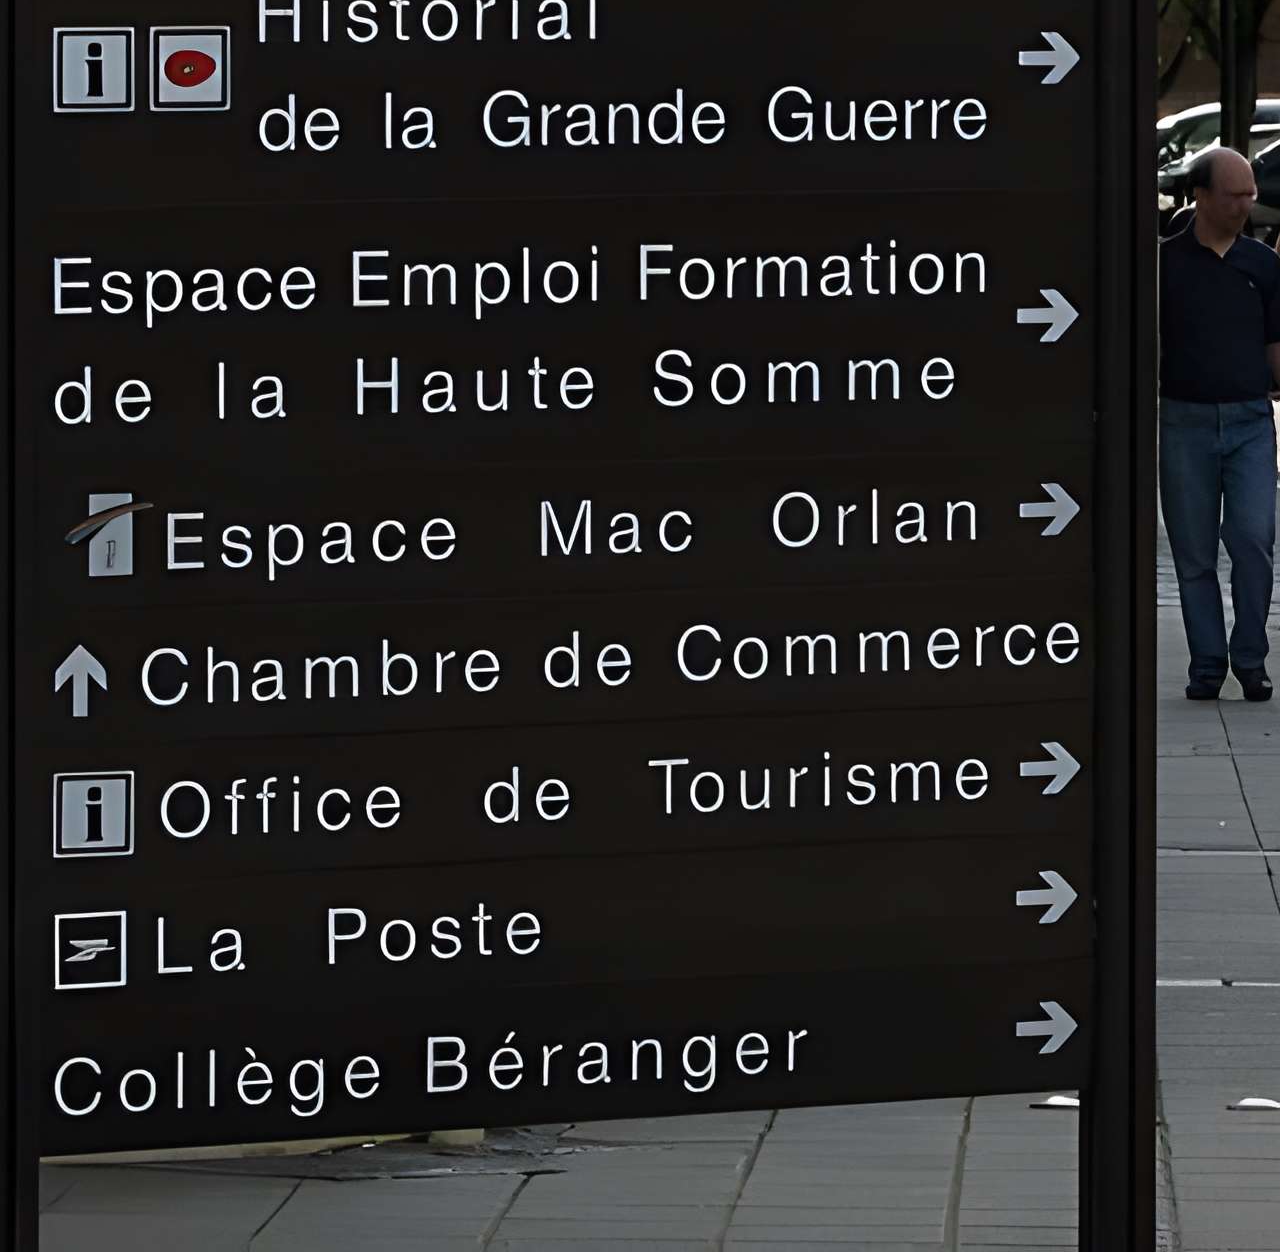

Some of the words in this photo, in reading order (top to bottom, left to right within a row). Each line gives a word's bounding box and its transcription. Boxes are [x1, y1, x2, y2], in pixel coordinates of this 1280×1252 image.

[258, 93, 340, 152] de
[385, 91, 437, 150] la
[482, 88, 726, 148] Grande
[767, 85, 988, 143] Guerre
[53, 256, 316, 329] Espace
[352, 246, 598, 321] Emploi
[639, 239, 986, 301] Formation
[54, 365, 152, 425] de
[218, 361, 287, 420] la
[356, 356, 594, 416] Haute
[653, 349, 955, 407] Somme
[167, 512, 456, 582] Espace
[540, 499, 693, 557] Mac
[772, 488, 977, 548] Orlan
[141, 638, 500, 706] Chambre
[544, 630, 632, 688] de
[677, 621, 1080, 682] Commerce
[160, 775, 401, 839] Office
[483, 766, 570, 824] de
[647, 758, 989, 815] Tourisme
[157, 916, 242, 974] La
[328, 902, 541, 965] Poste
[54, 1046, 380, 1117] Collège
[426, 1029, 808, 1093] Béranger
